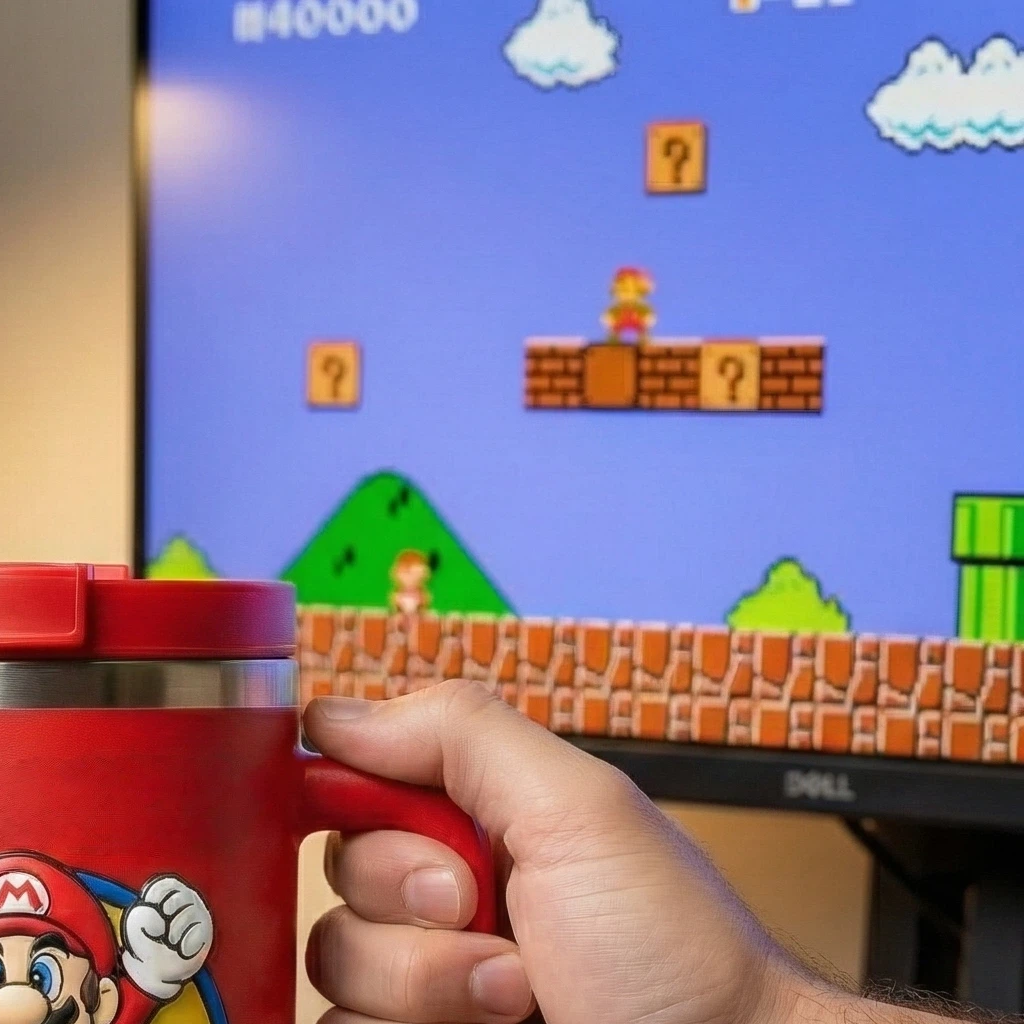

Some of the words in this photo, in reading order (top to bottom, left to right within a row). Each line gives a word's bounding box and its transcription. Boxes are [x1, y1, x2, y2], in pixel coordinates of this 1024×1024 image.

[664, 137, 690, 184] ?
[322, 355, 347, 394] ?
[716, 355, 748, 403] ?
